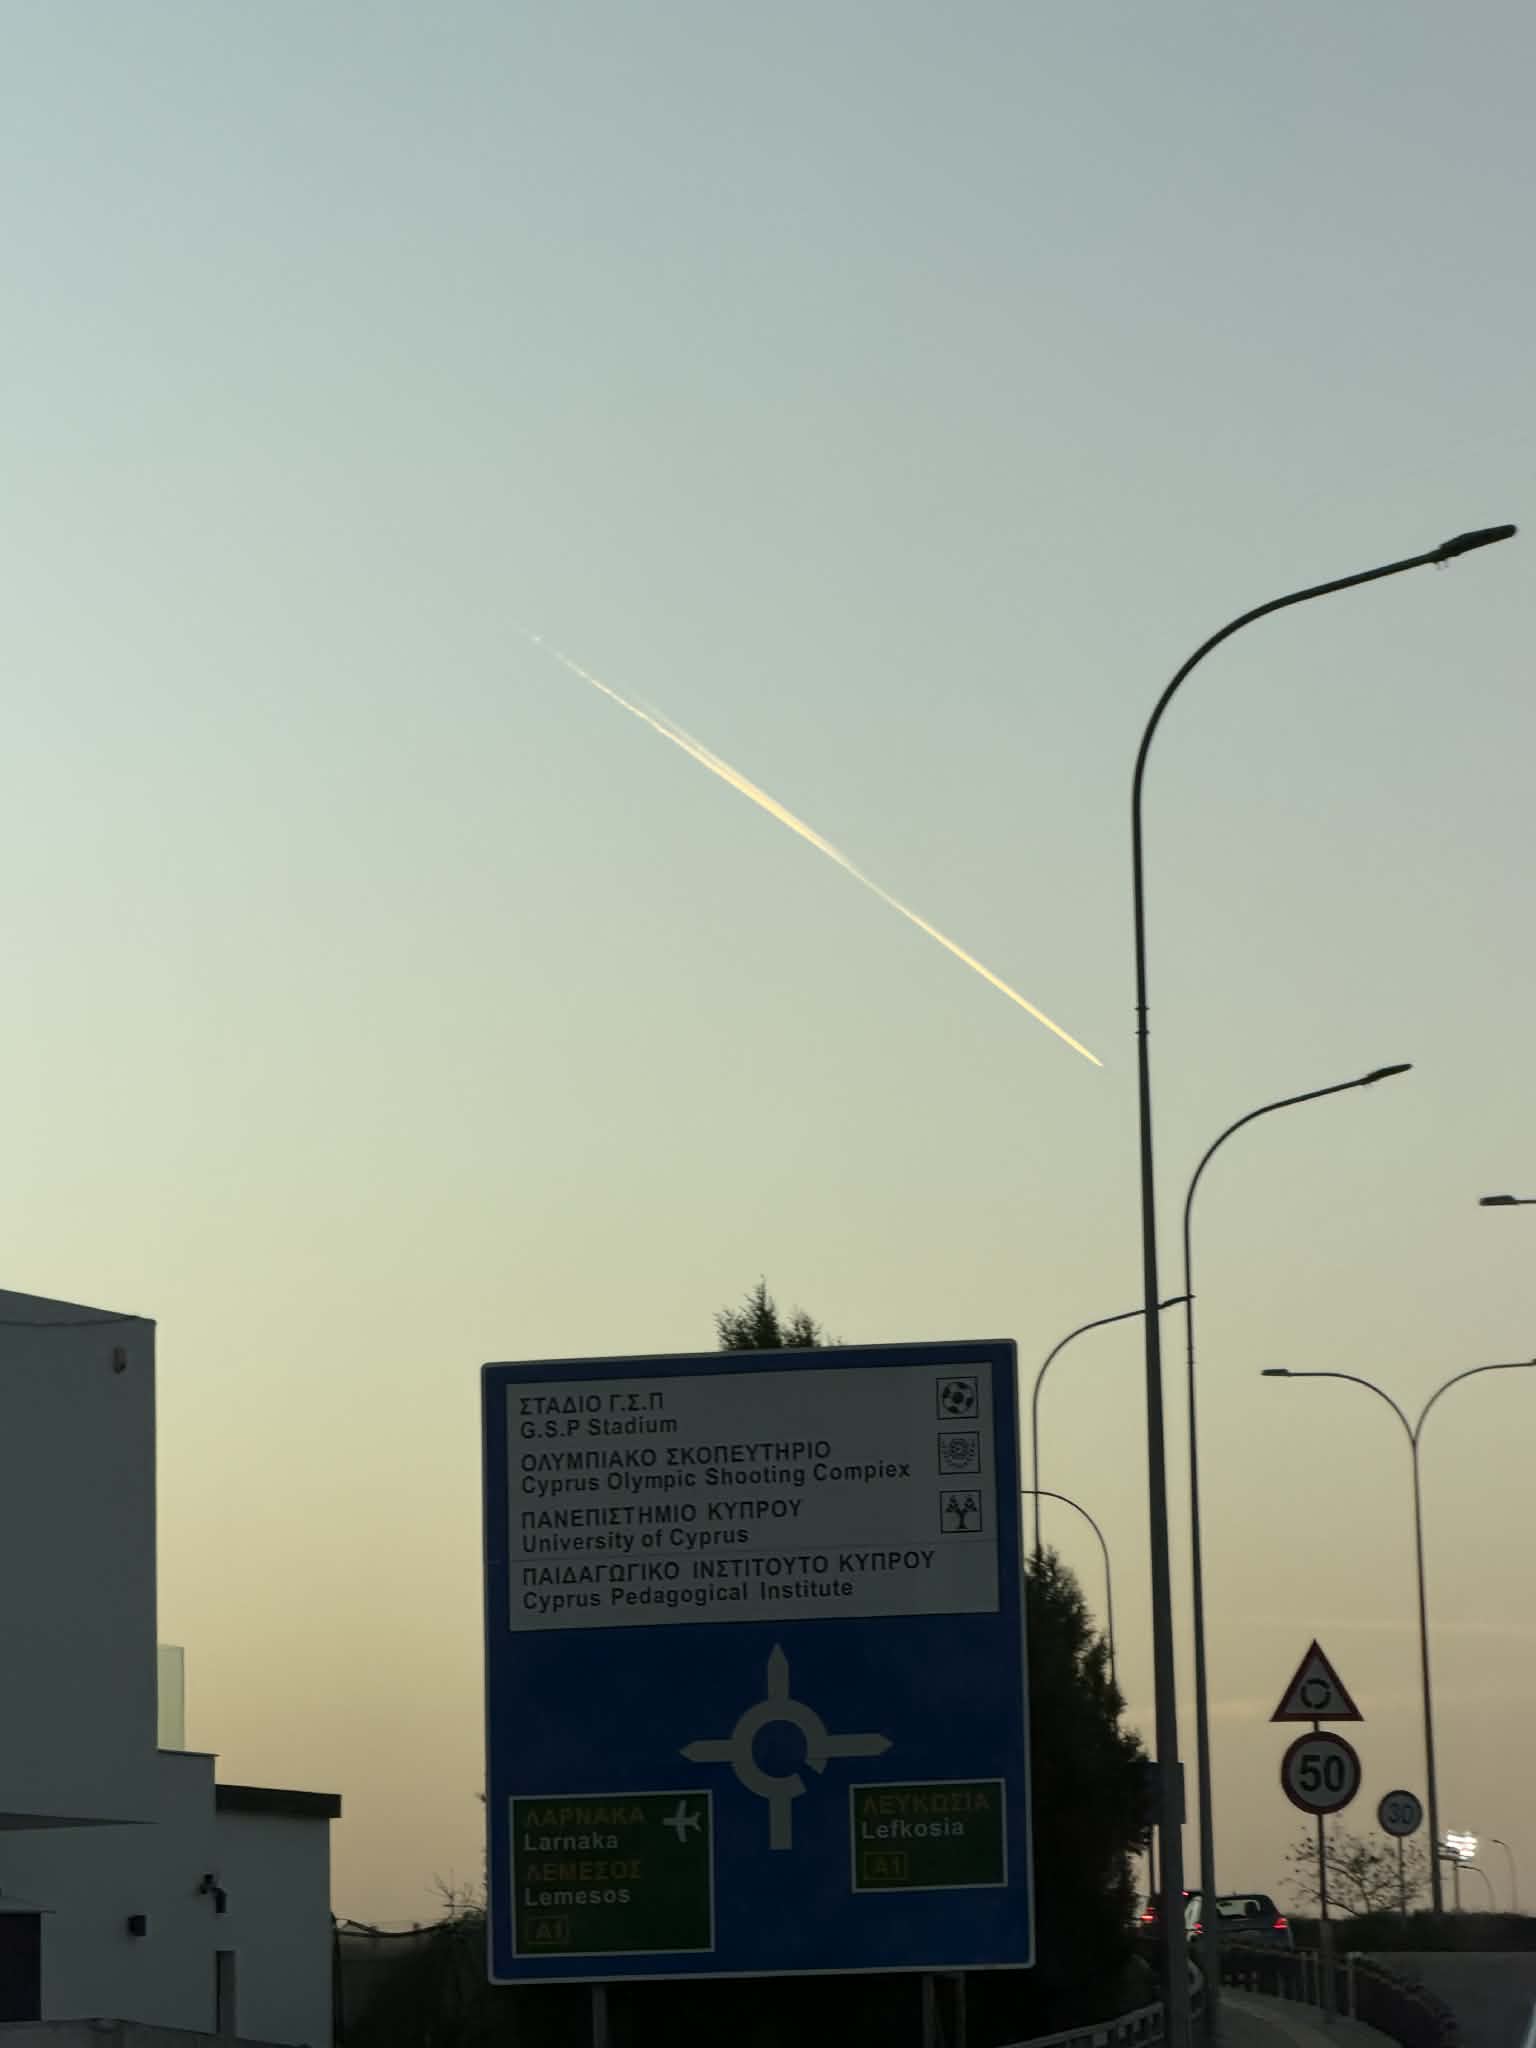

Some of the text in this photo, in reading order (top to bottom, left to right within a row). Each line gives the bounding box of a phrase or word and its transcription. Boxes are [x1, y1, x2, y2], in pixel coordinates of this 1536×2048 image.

[520, 1395, 602, 1415] ΣΤΑΔΙΟ
[520, 1416, 678, 1439] G.S.P Stadium
[521, 1440, 831, 1472] ΟΛΥΜΠΙΑΚΟ ΣΚΟΠΕΥΤΗΡΙΟ
[522, 1475, 600, 1497] Cyprus
[607, 1471, 696, 1494] Olympic
[704, 1465, 806, 1487] Shooting
[521, 1499, 801, 1529] ΠΑΝΕΠΙΣΤΗΜΙΟ ΚΥΠΡΟΥ
[522, 1527, 749, 1552] University of Cyprus
[523, 1551, 935, 1585] ΠΑΙΔΑΓΩΓΙΚΟ ΙΝΣΤΙΤΟΥΤΟ ΚΥΠΡΟΥ
[523, 1580, 854, 1613] Cyprus Pedagogical Institute
[1299, 1754, 1345, 1792] 50
[1388, 1802, 1414, 1824] 30
[862, 1817, 966, 1840] Lefkosia
[523, 1831, 619, 1852] Larnaka
[524, 1887, 632, 1908] Lemesos
